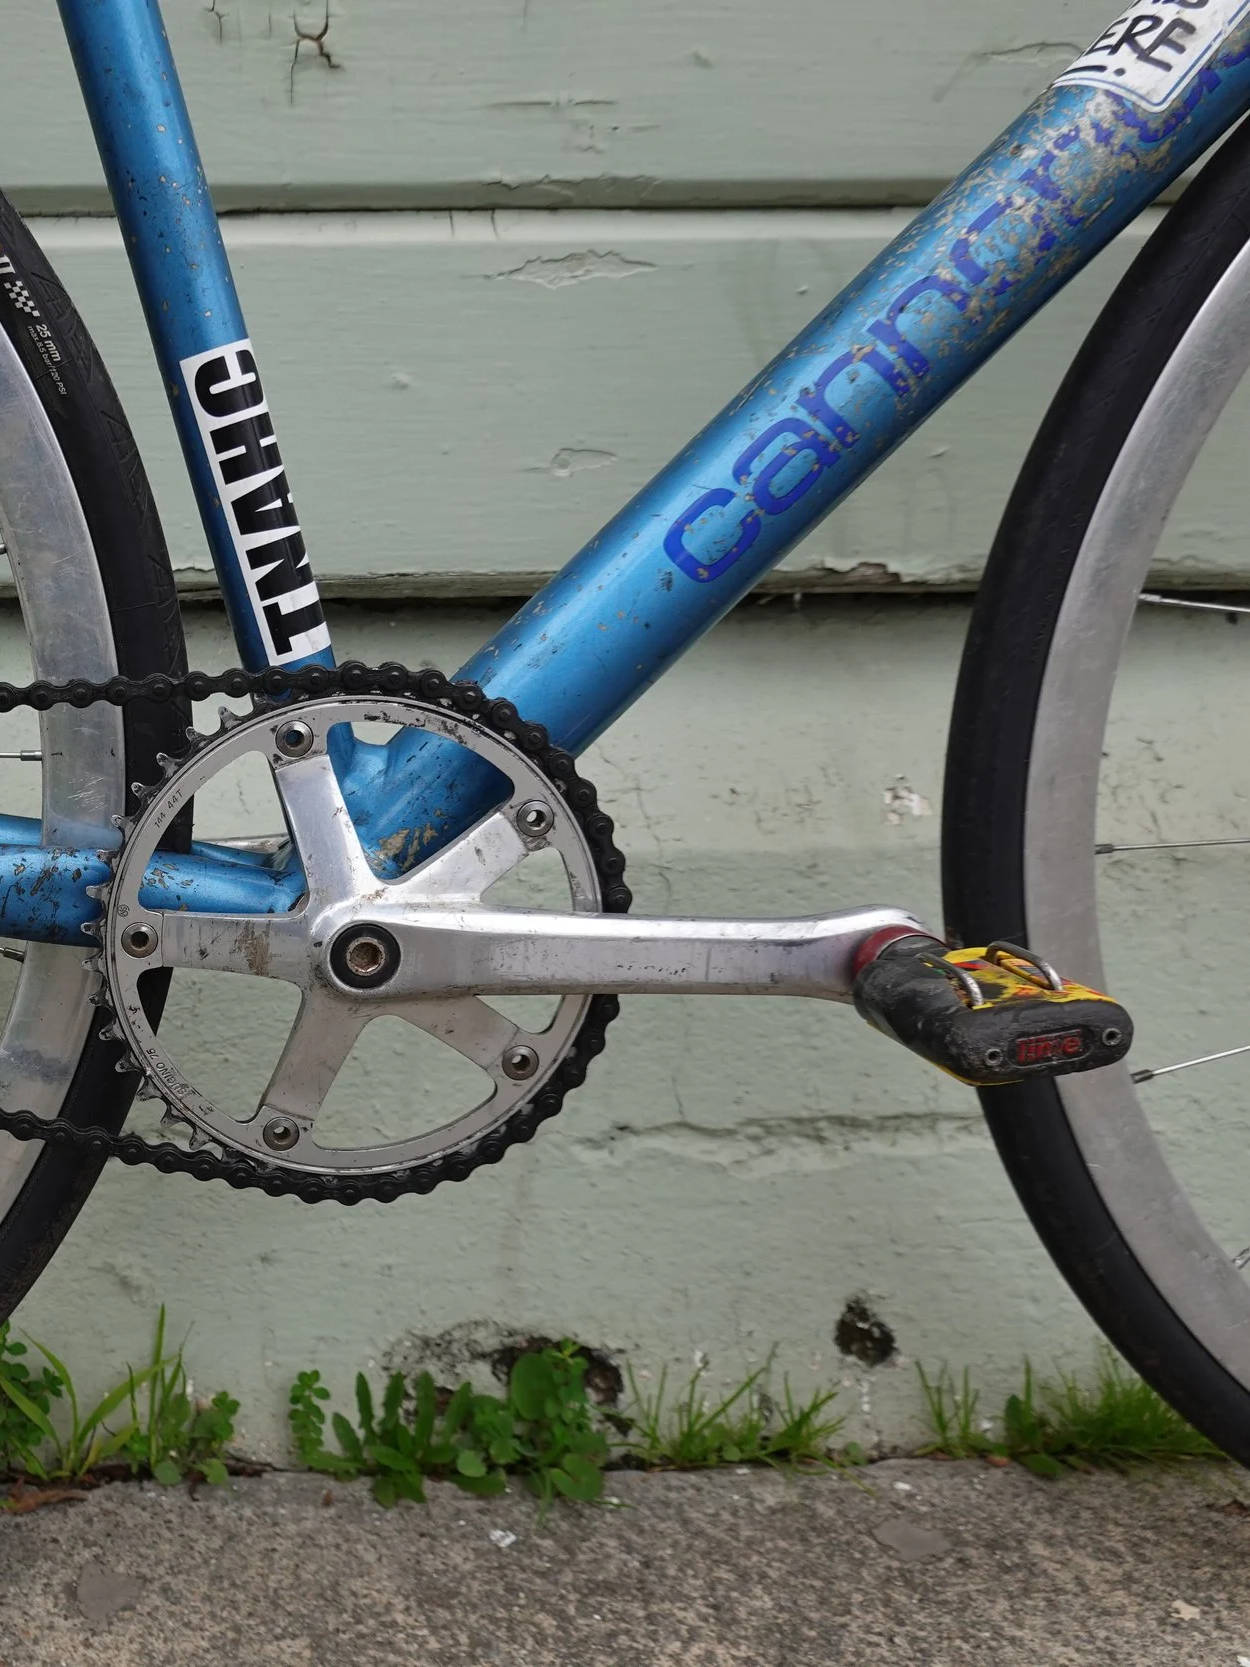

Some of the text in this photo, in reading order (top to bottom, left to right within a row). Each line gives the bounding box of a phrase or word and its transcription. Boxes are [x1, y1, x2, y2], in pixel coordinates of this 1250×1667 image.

[36, 324, 61, 361] 25 mm
[56, 382, 67, 395] PSI
